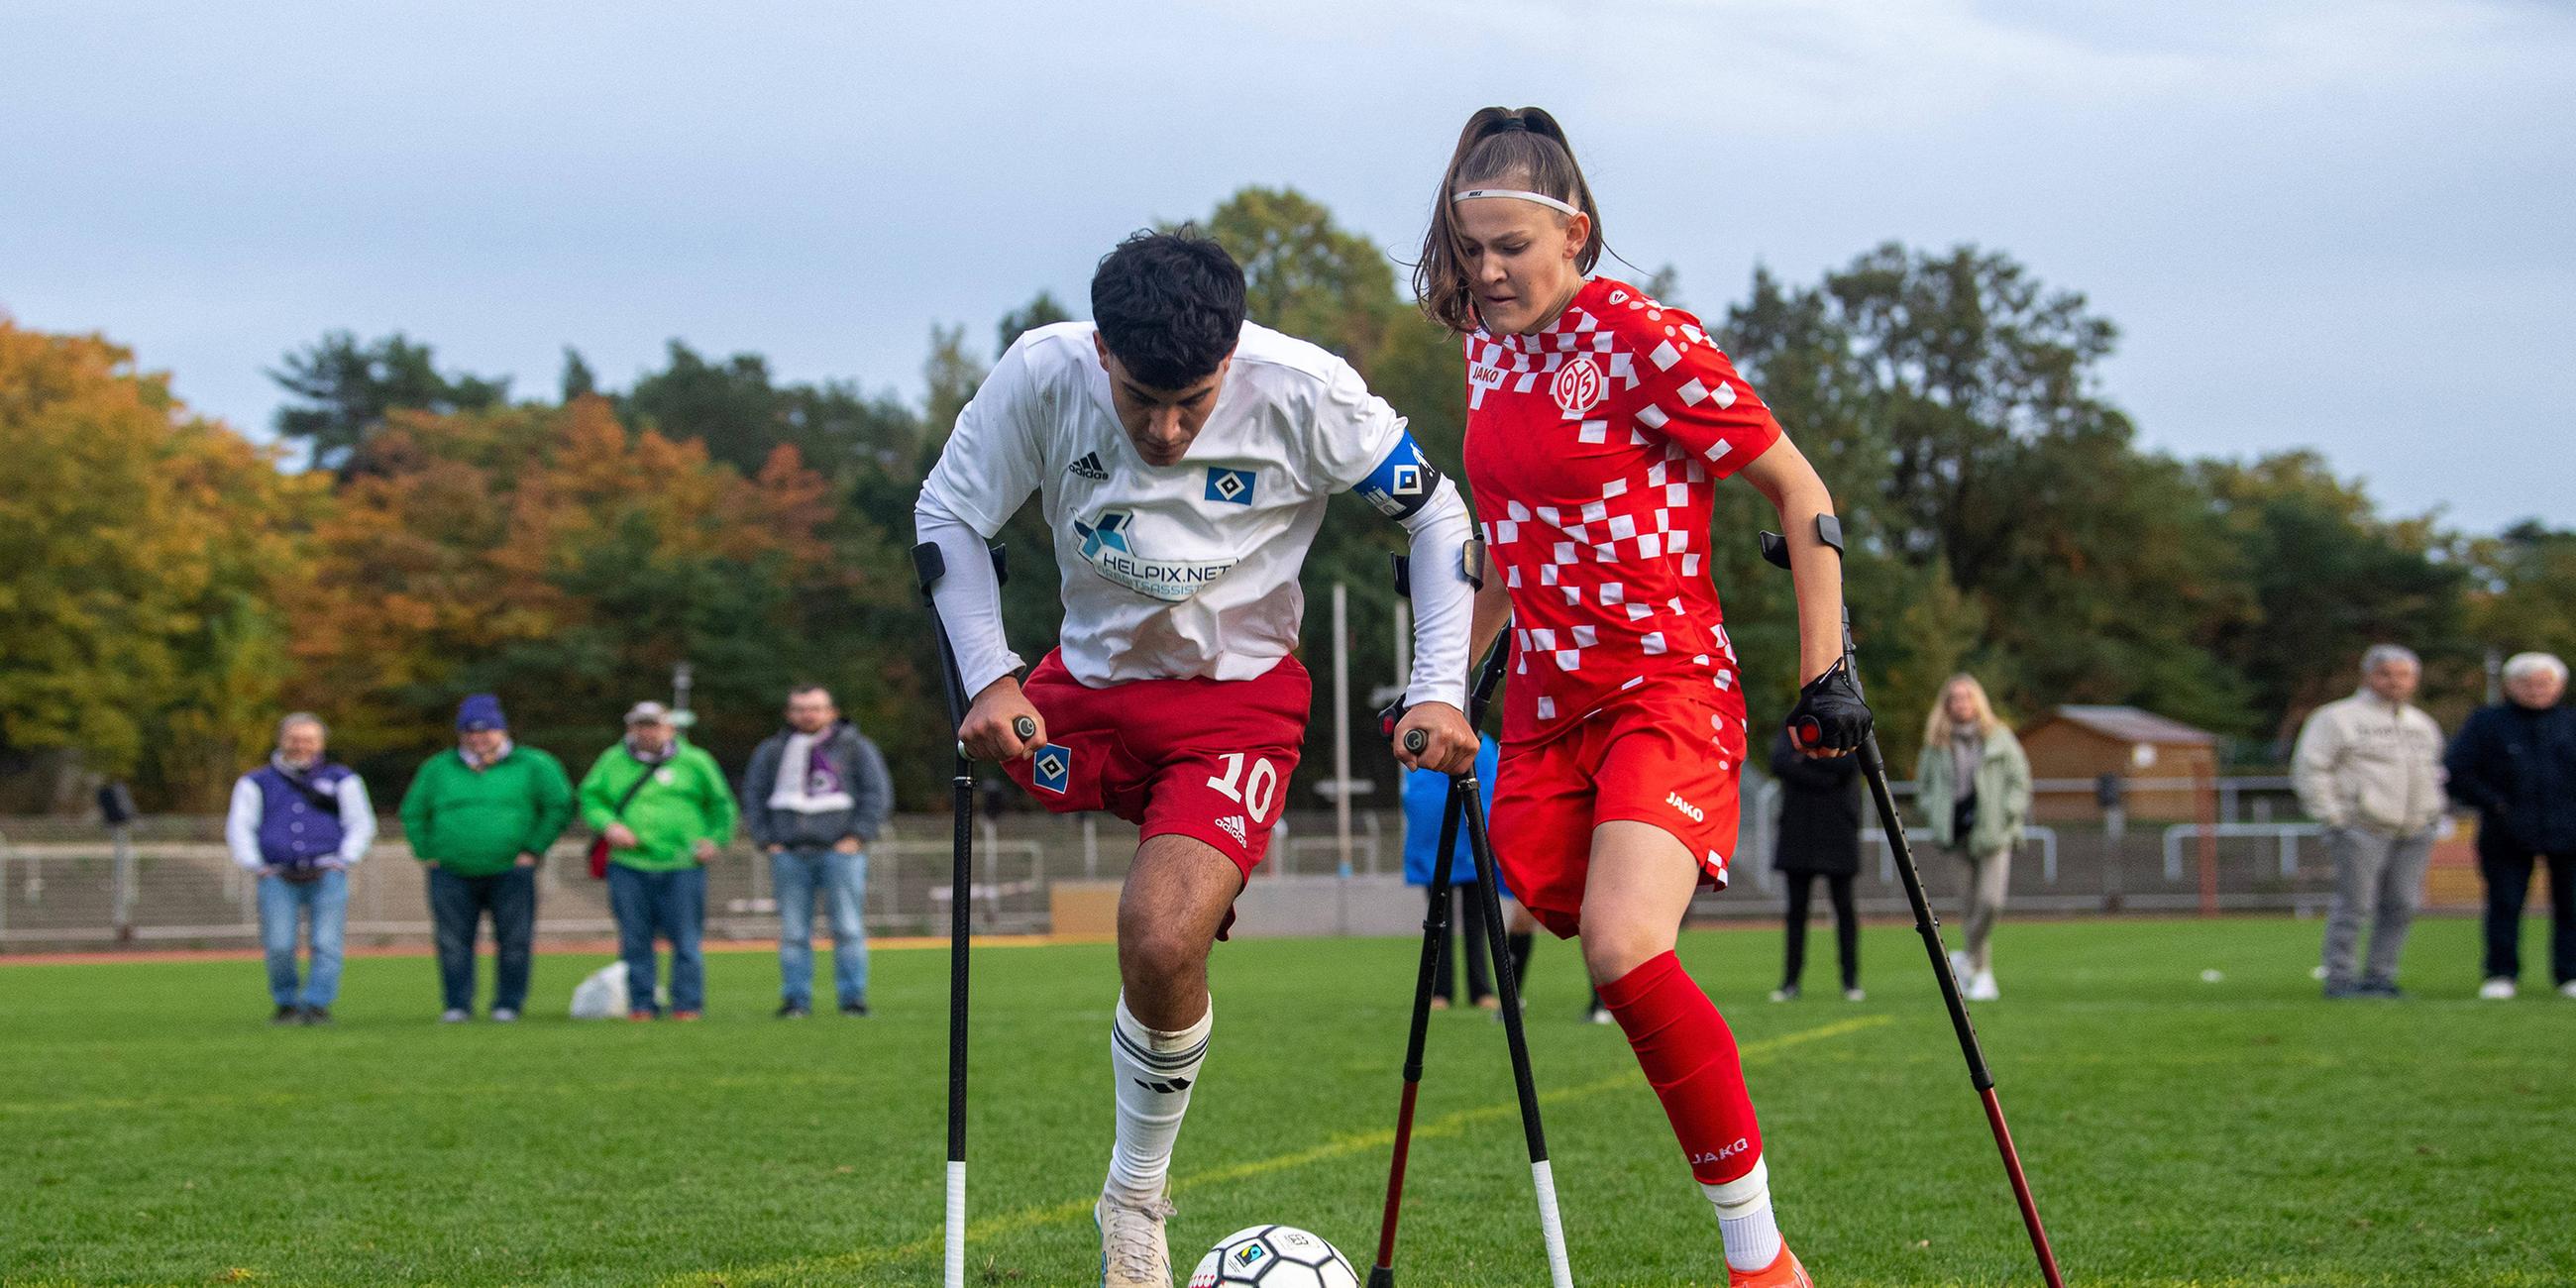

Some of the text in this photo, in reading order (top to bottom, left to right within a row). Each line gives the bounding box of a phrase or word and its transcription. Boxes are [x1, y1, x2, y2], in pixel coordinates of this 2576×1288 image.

[1472, 366, 1499, 383] JAKO
[1068, 464, 1109, 481] adidas
[1104, 552, 1232, 584] HELPIX.NET
[1206, 752, 1277, 823] 10
[1665, 791, 1704, 823] JAKO
[1215, 818, 1247, 849] adidas
[1692, 1137, 1749, 1164] JAKO
